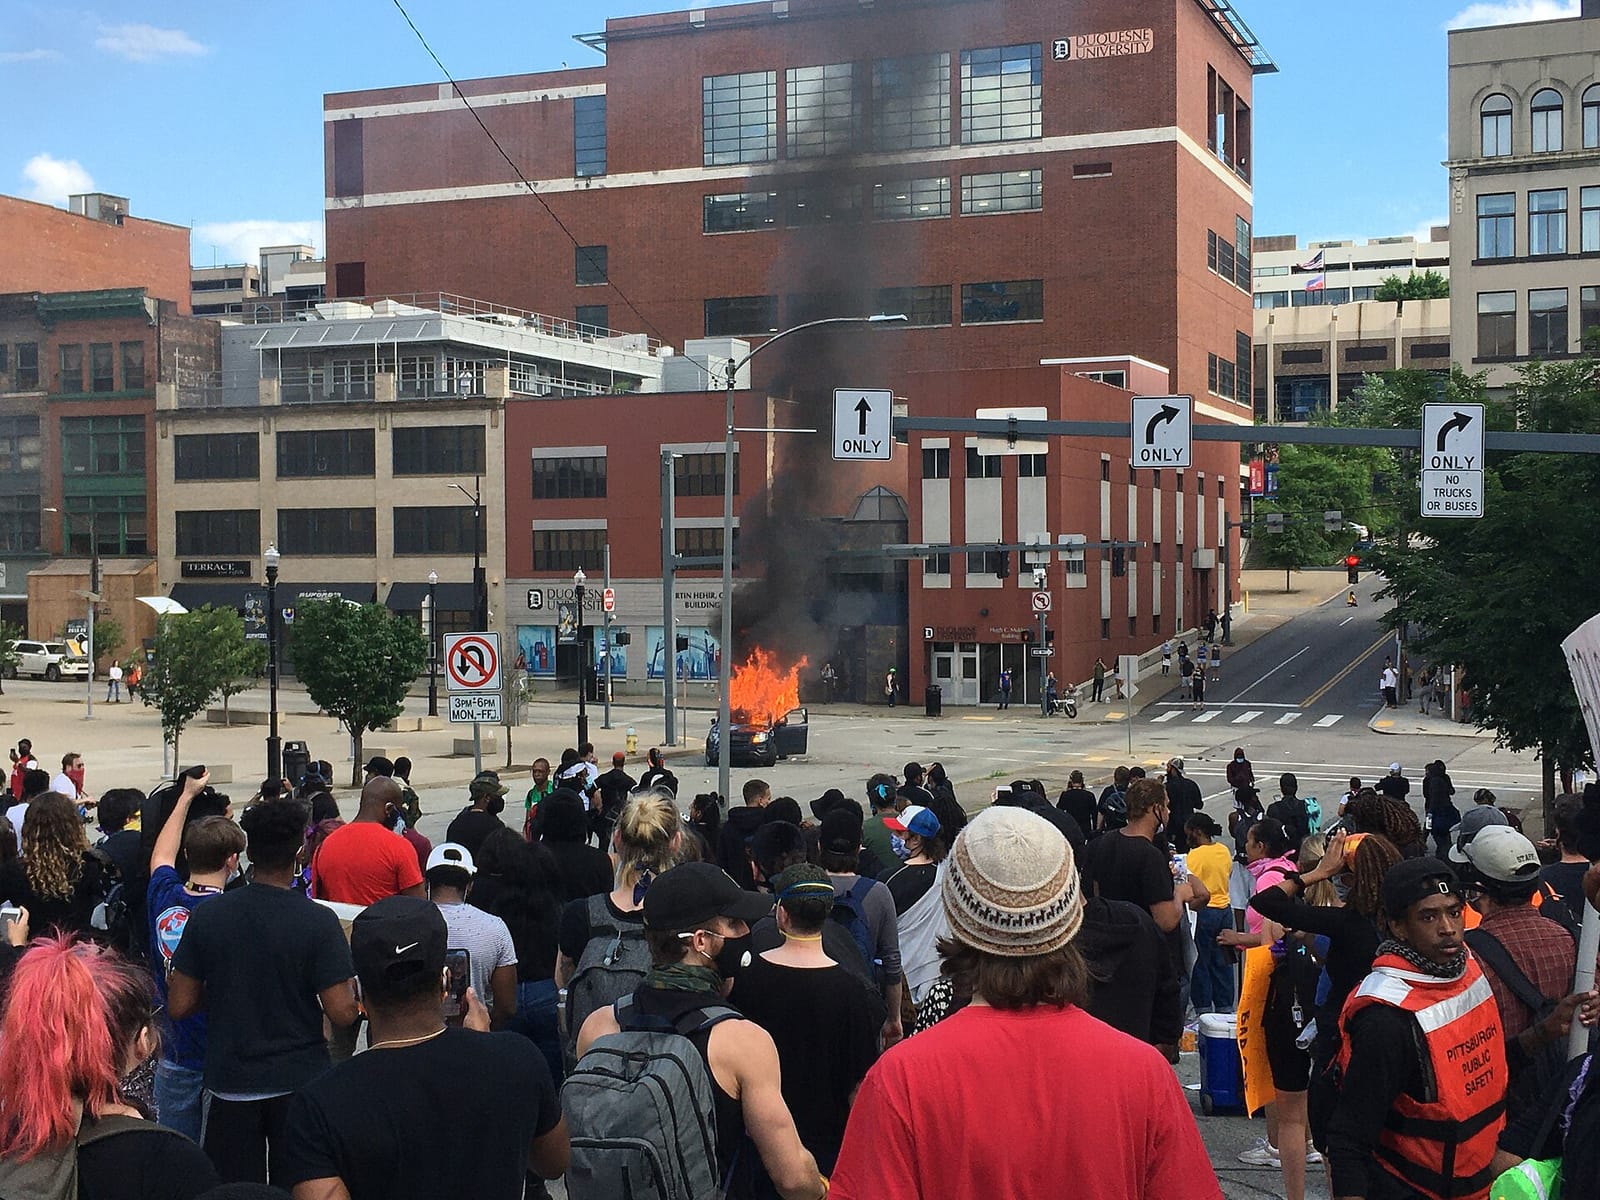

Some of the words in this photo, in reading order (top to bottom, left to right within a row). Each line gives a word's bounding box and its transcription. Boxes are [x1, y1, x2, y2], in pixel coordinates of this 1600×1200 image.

[1076, 28, 1150, 47] DUQUESNE
[1076, 41, 1150, 59] UNIVERSITY
[843, 440, 881, 453] ONLY
[1141, 448, 1183, 461] ONLY
[1431, 456, 1475, 469] ONLY
[1445, 475, 1460, 485] NO
[1433, 488, 1472, 498] TRUCKS
[1427, 501, 1441, 511] OR
[1445, 501, 1478, 511] BUSES
[187, 563, 235, 571] TERRACE
[547, 588, 604, 600] DUQESN
[684, 601, 721, 609] BUILDING
[1446, 1023, 1498, 1063] PITTSBURGH
[1461, 1048, 1492, 1077] PUBLIC
[1464, 1066, 1495, 1097] SAFETY
